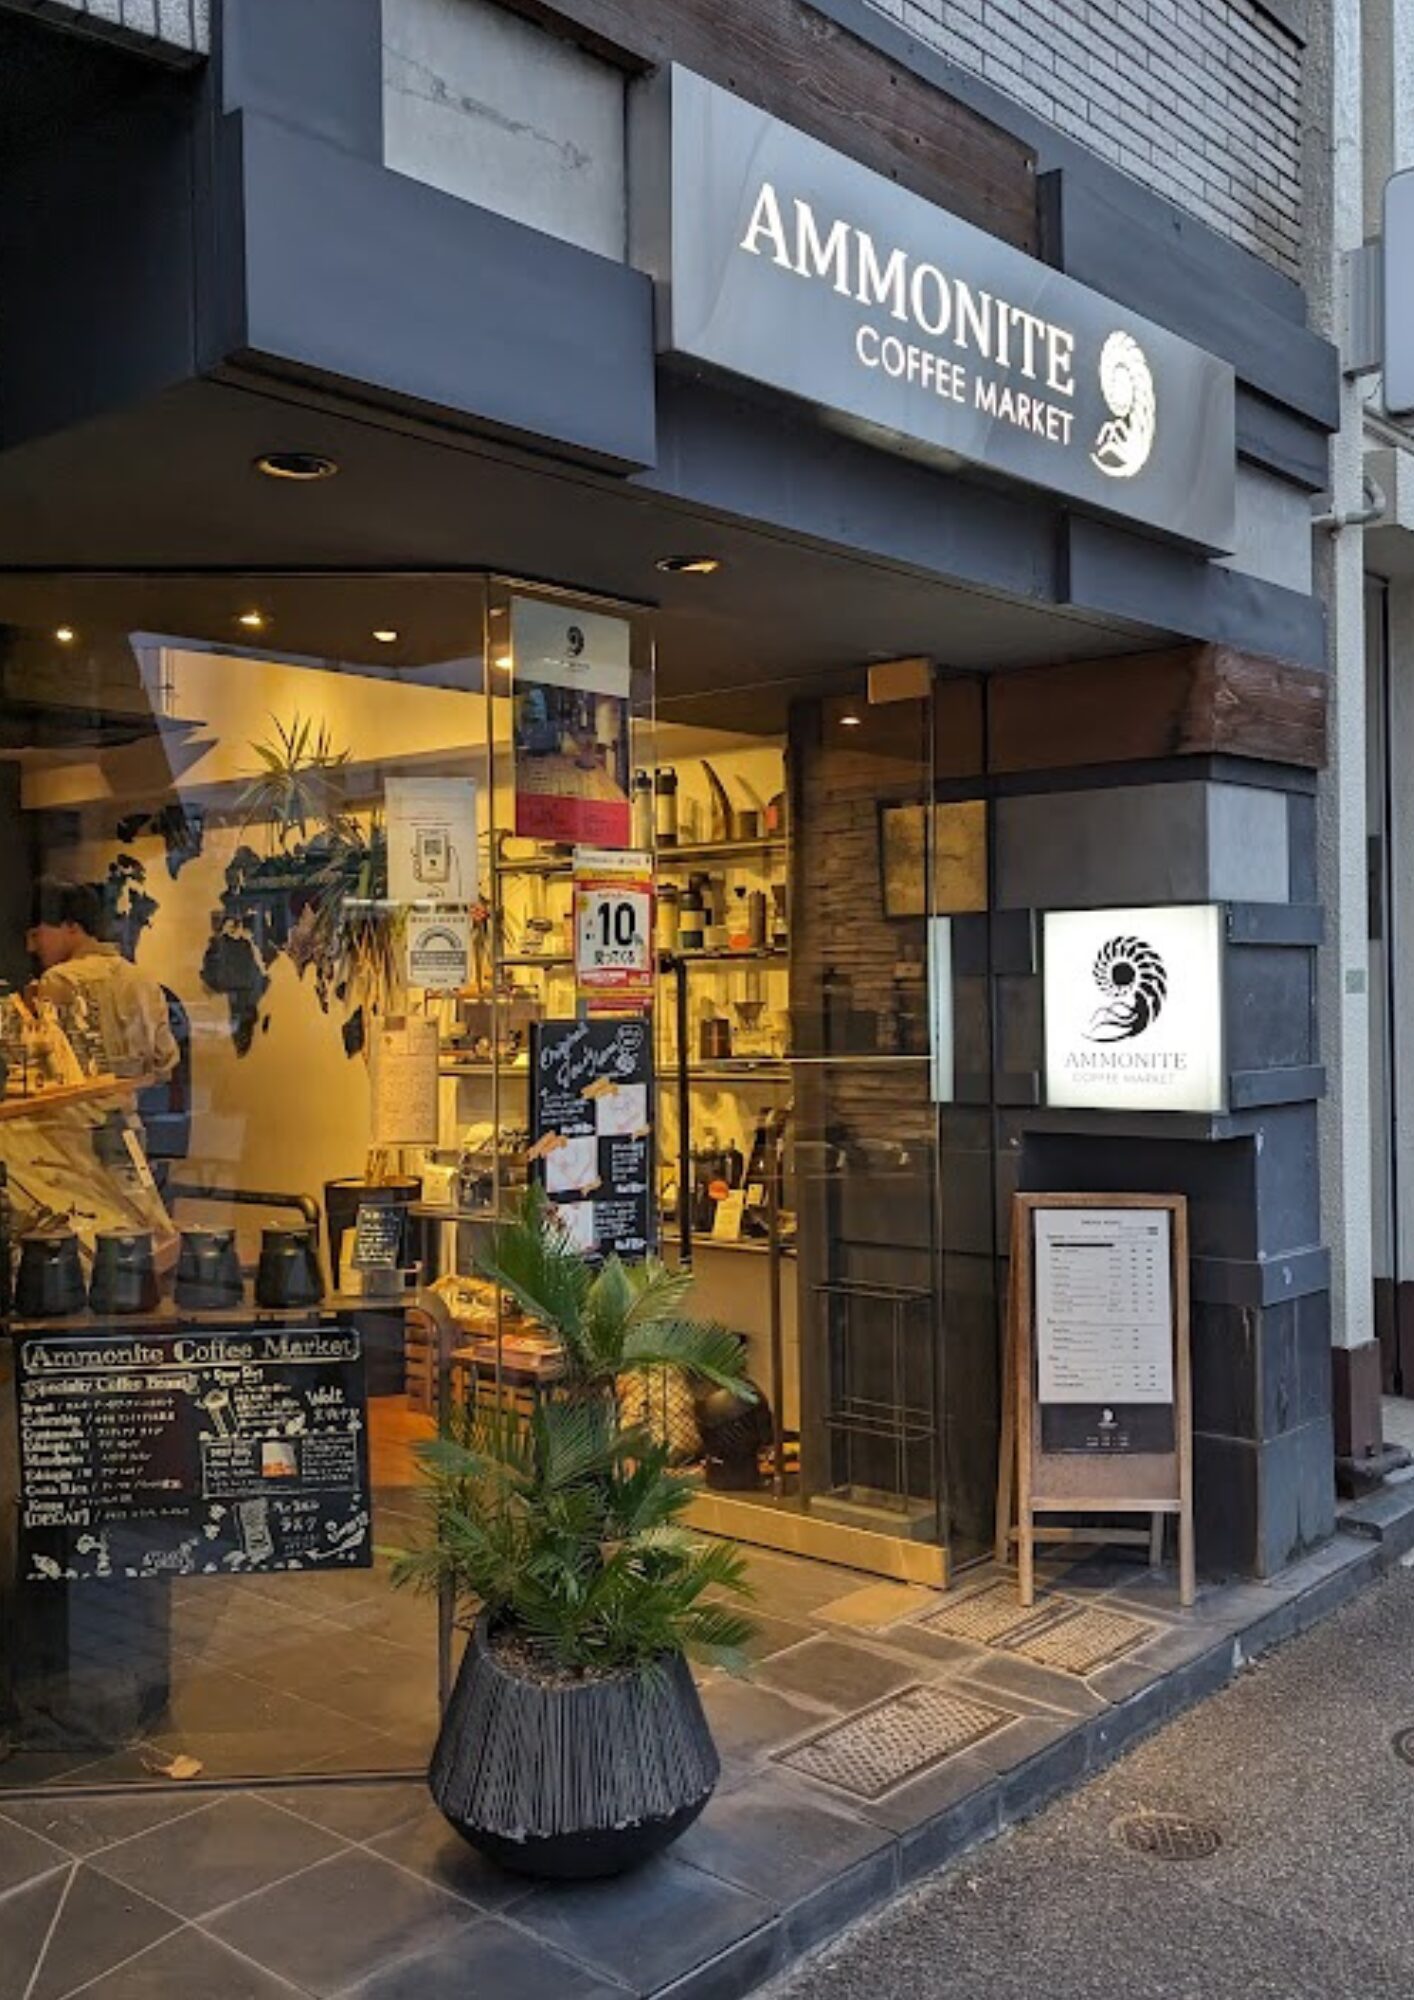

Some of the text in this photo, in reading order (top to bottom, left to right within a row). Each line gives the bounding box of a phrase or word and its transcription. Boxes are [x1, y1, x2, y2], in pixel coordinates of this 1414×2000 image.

[739, 182, 1076, 397] AMMONITE
[855, 324, 1075, 446] COFFEE MARKET
[1064, 1052, 1187, 1070] AMMONITE
[1072, 1072, 1176, 1085] COFFEE MARKET
[30, 1333, 353, 1368] Ammonite Coffee Market
